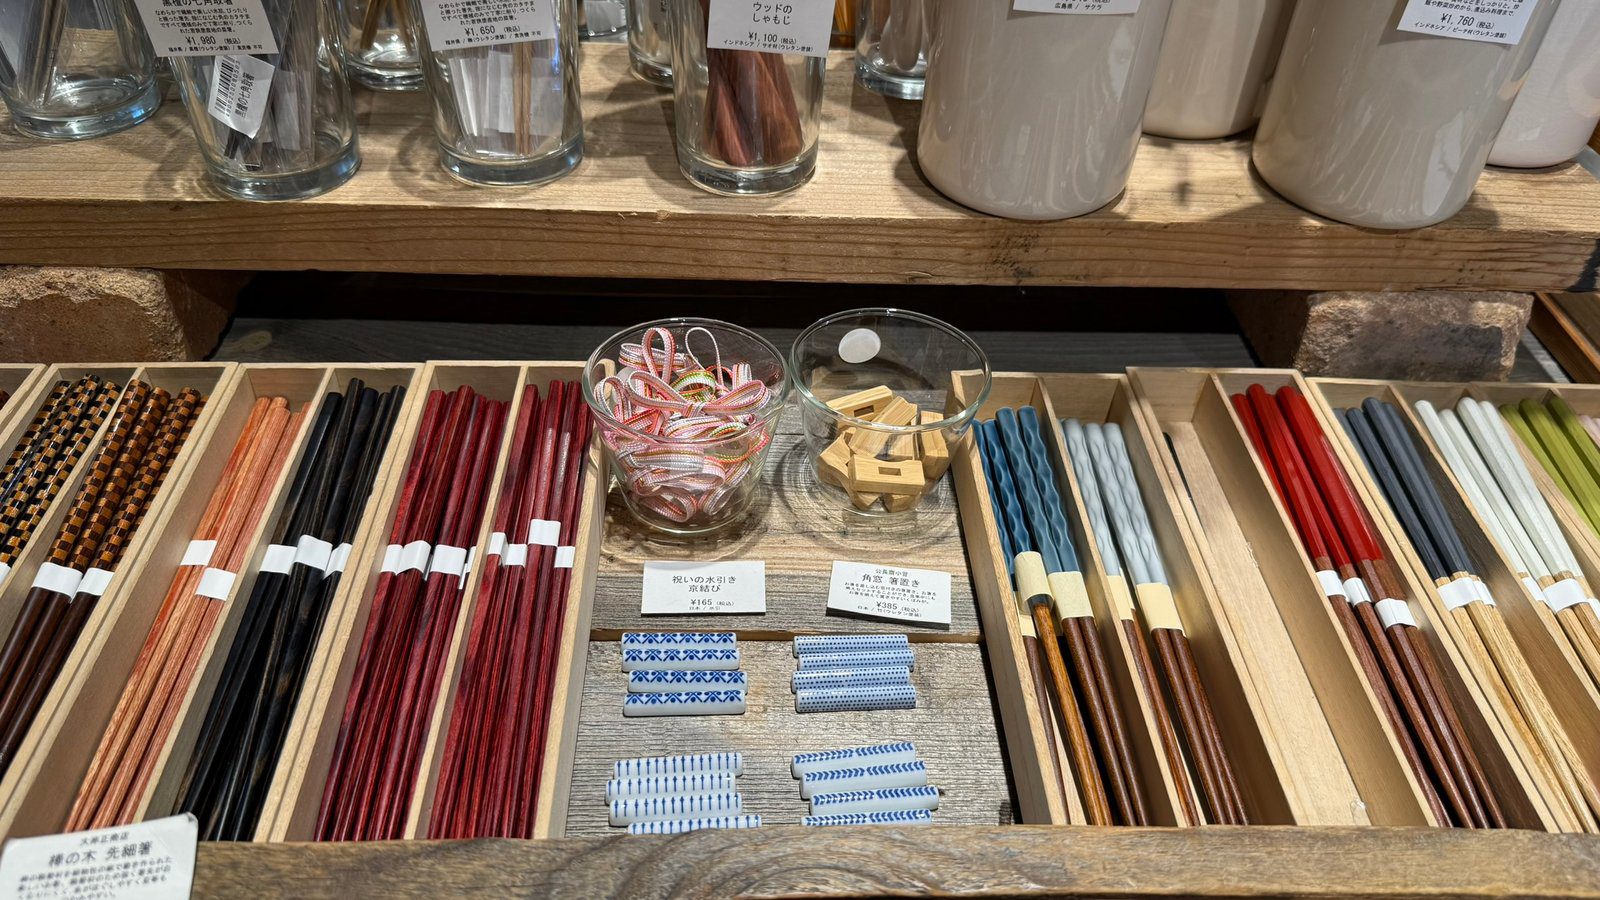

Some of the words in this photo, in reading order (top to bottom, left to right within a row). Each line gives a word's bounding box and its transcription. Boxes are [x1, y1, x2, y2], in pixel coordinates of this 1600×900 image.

[753, 2, 792, 14] ウッドの
[753, 13, 790, 25] しゃもじ
[1440, 13, 1475, 26] ¥1,760
[465, 25, 495, 36] ¥1,650
[1414, 22, 1445, 31] インドネシア
[185, 36, 216, 45] ¥1,980
[748, 31, 778, 43] ¥1,100
[672, 575, 736, 584] 祝いの水引き
[862, 573, 883, 583] 角窓
[889, 576, 920, 588] 箸置き
[688, 584, 721, 593] 京結び
[876, 601, 898, 610] ¥385
